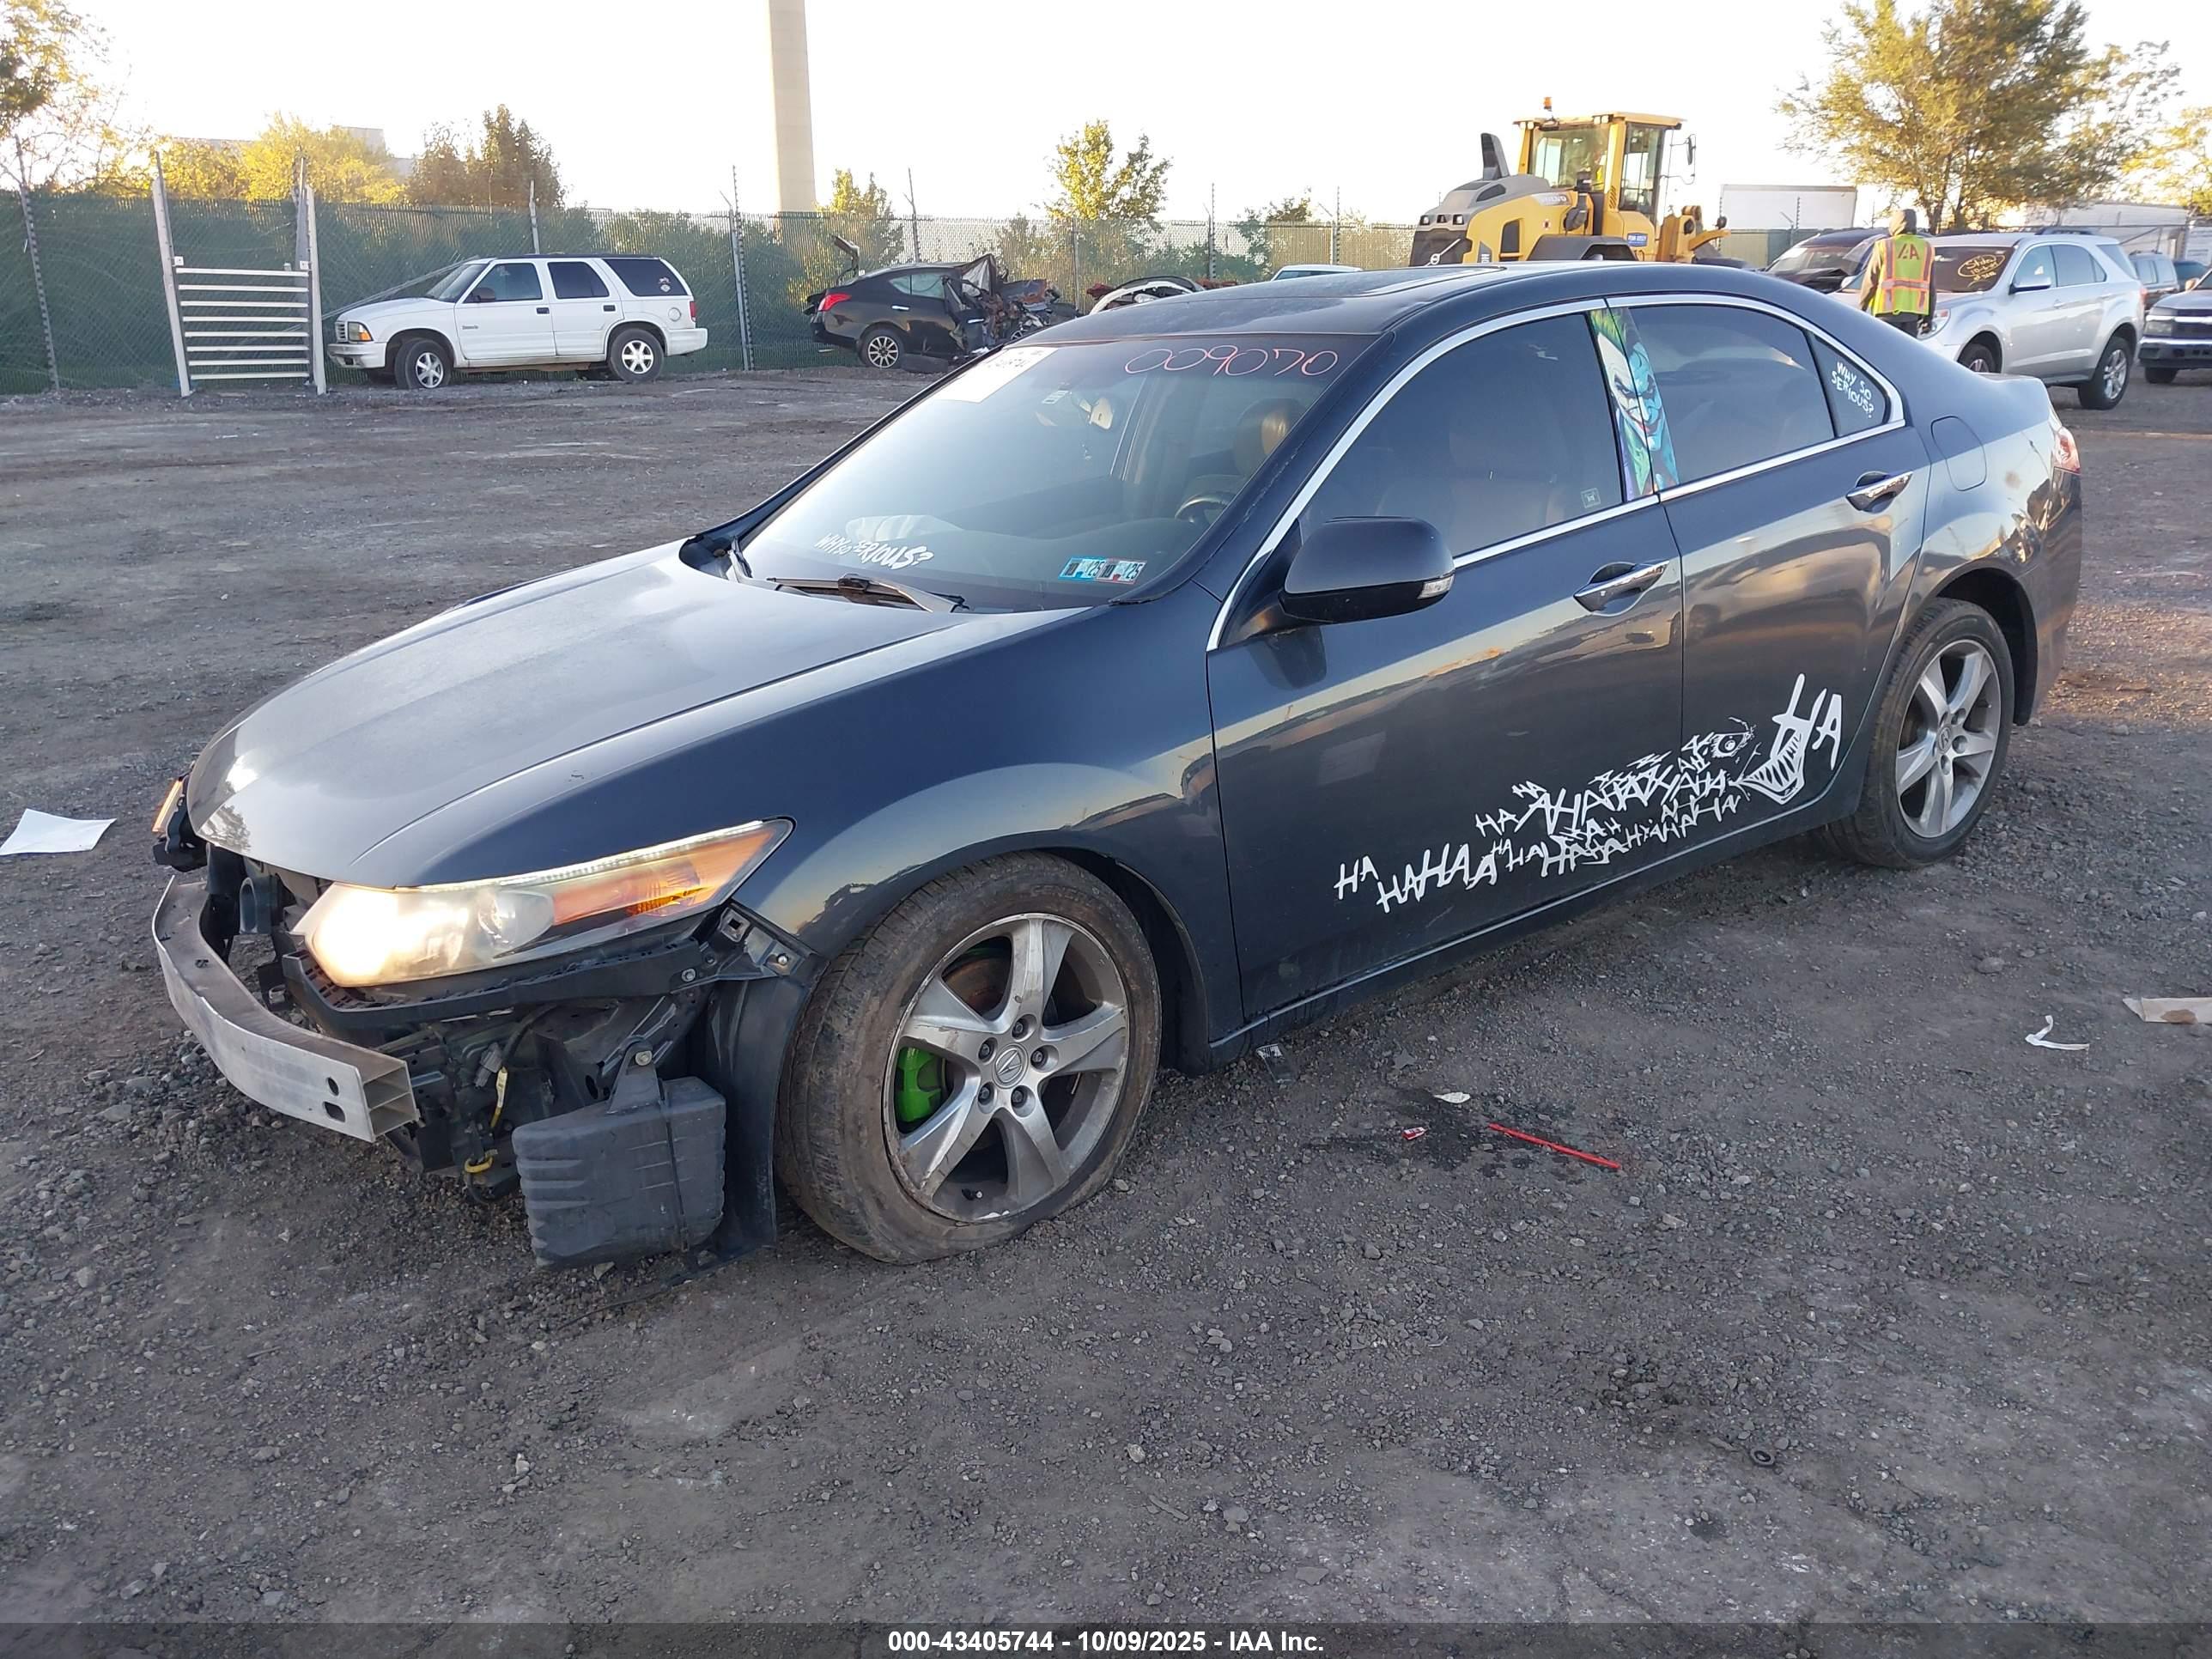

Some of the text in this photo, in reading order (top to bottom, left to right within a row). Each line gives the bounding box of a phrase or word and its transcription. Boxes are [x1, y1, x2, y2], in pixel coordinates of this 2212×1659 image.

[1125, 345, 1338, 376] 009070
[1831, 370, 1875, 418] SERIOUS?
[1837, 362, 1872, 400] WHY SO
[853, 540, 934, 570] SERIOUS?
